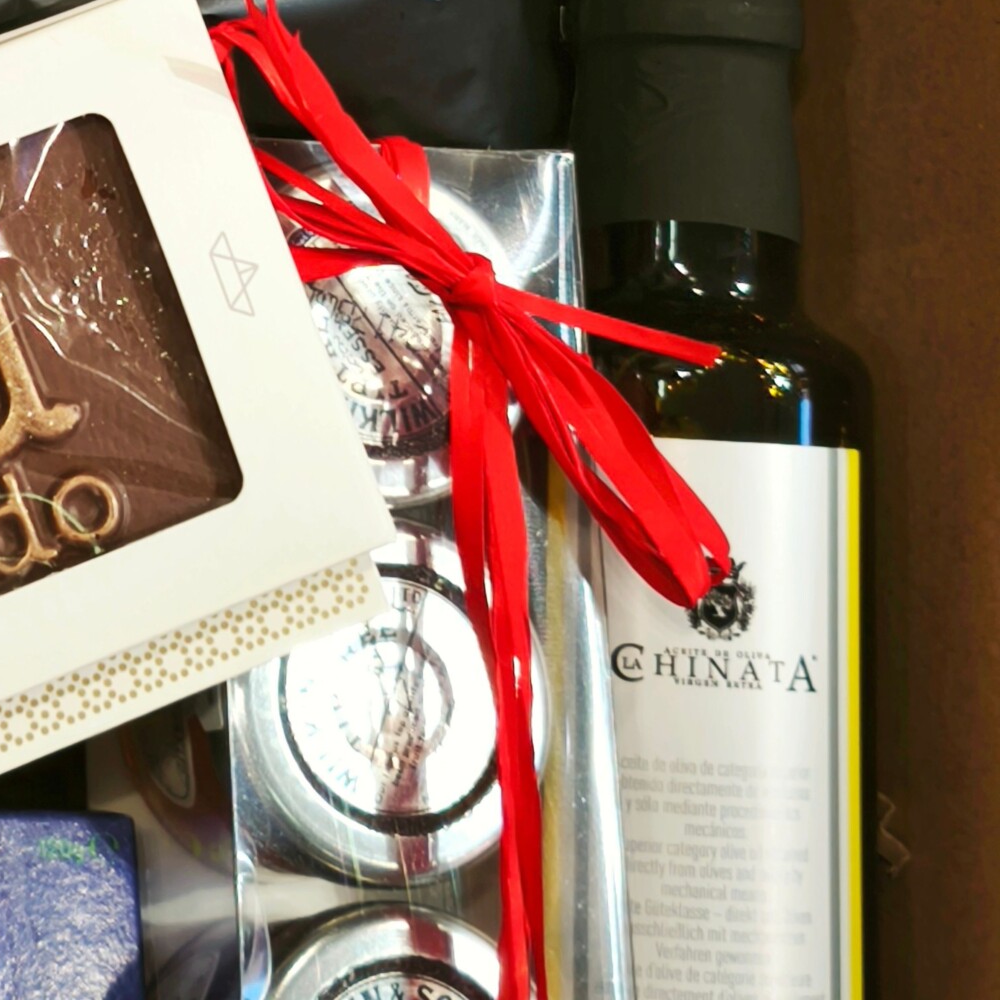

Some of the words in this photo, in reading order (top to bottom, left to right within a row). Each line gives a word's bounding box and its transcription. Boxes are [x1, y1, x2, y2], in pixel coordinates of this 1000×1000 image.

[664, 647, 707, 657] ACEITE
[715, 648, 729, 657] DE
[736, 651, 771, 660] OLIVA
[674, 679, 718, 688] VIRGEN
[726, 681, 763, 690] EXTRA
[667, 777, 743, 798] directamente
[666, 842, 717, 863] category
